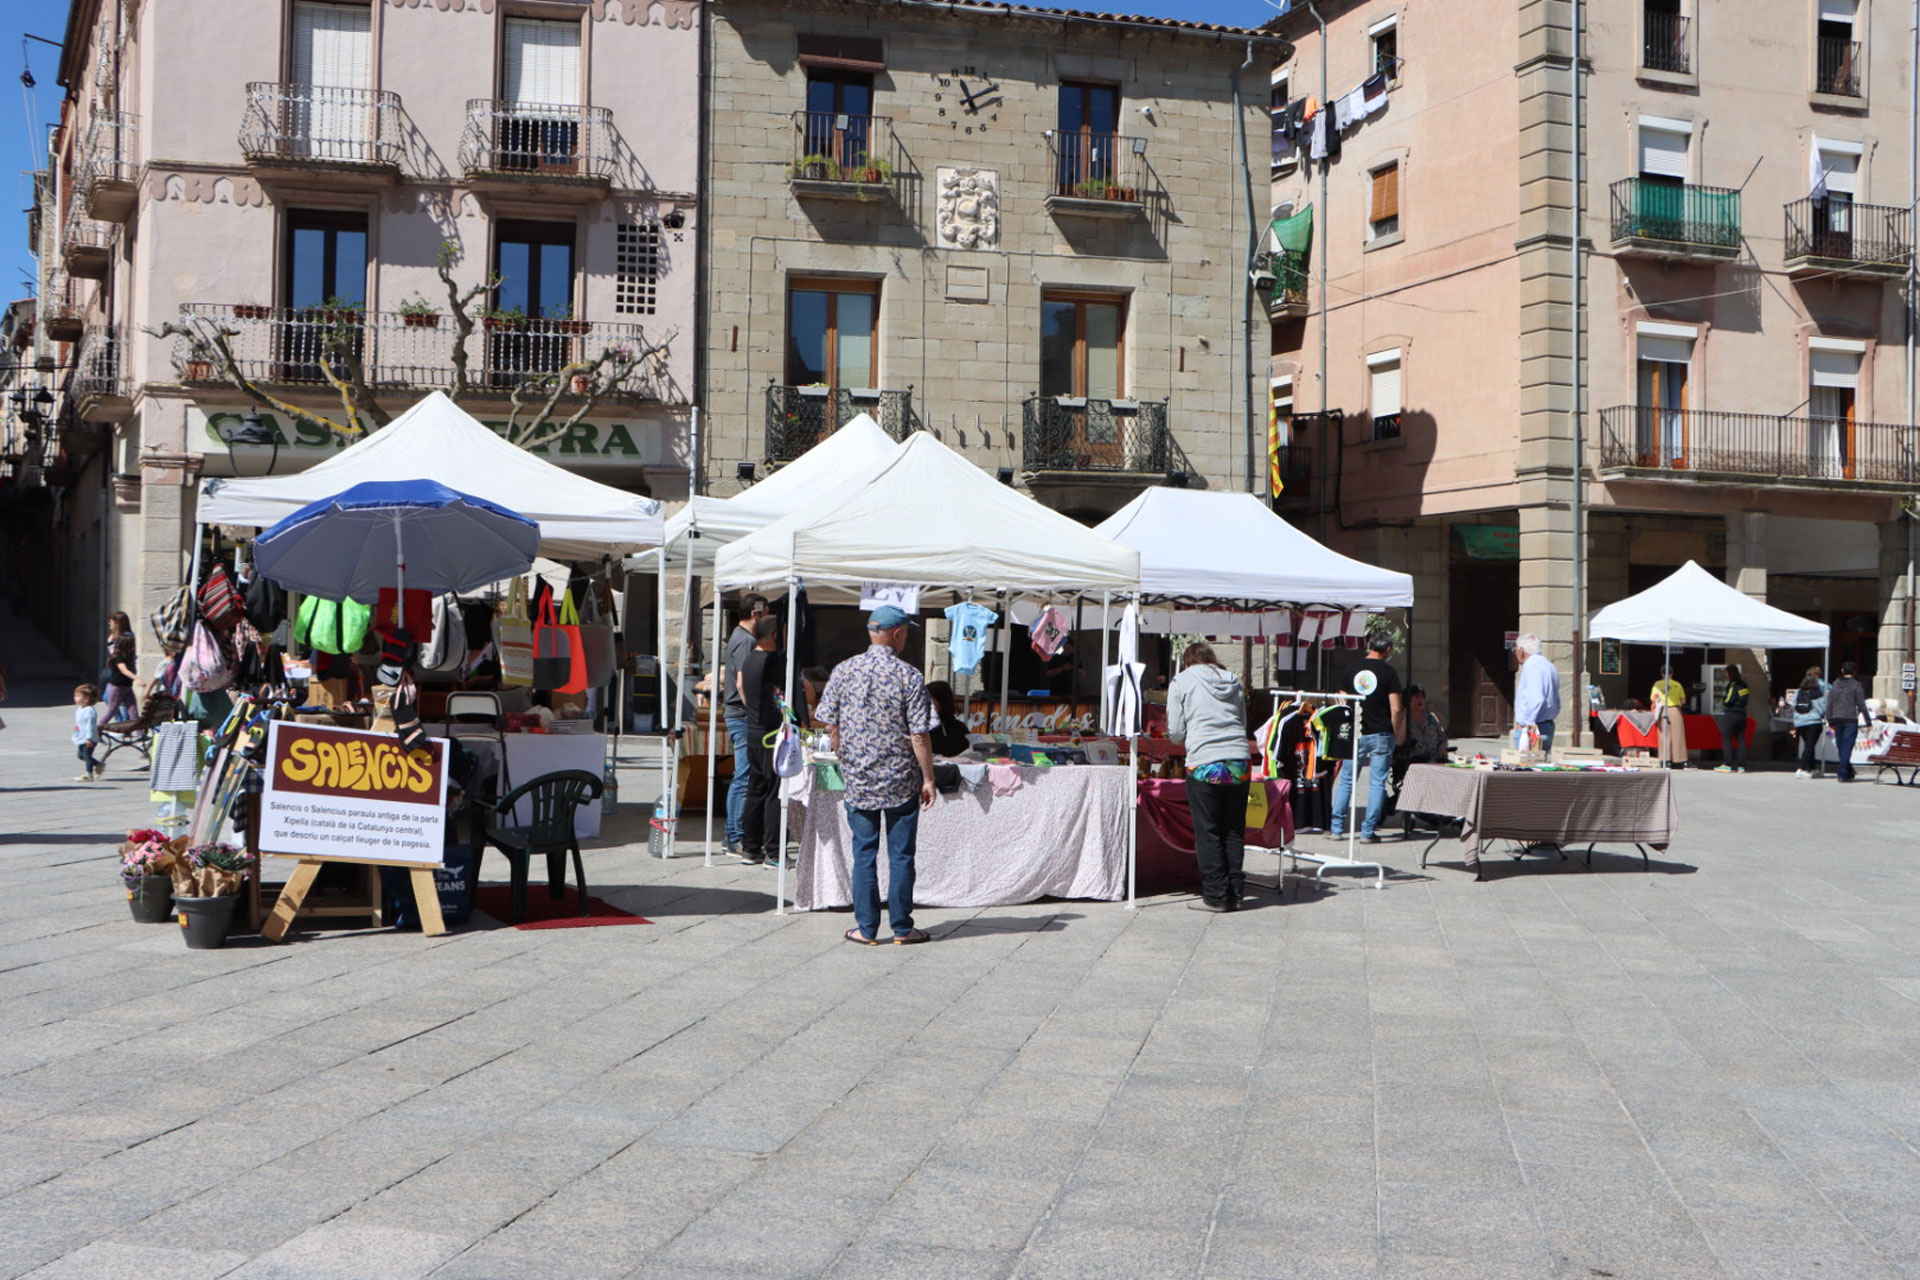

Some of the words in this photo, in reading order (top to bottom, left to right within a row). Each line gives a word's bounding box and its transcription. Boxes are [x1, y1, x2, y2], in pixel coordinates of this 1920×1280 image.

[951, 68, 959, 78] 11
[964, 66, 976, 74] 12
[940, 79, 951, 87] 10
[935, 93, 942, 102] 9
[939, 107, 946, 117] 8
[991, 113, 998, 122] 4
[951, 121, 958, 130] 7
[980, 123, 987, 132] 5
[965, 126, 972, 135] 6
[206, 412, 370, 448] CAS
[270, 801, 302, 812] Salencis
[311, 805, 347, 816] Salencius
[348, 809, 376, 818] paraula
[377, 811, 400, 822] antiga
[401, 813, 411, 821] de
[412, 813, 419, 822] la
[420, 815, 439, 824] parla
[283, 816, 309, 826] Xipella
[337, 820, 347, 829] de
[349, 821, 356, 830] la
[357, 822, 394, 833] Catalunya
[274, 830, 288, 838] que
[290, 831, 318, 840] descriu
[331, 834, 354, 844] calçat
[355, 836, 380, 846] lleuger
[382, 837, 391, 845] de
[393, 838, 400, 846] la
[437, 881, 466, 891] EANS
